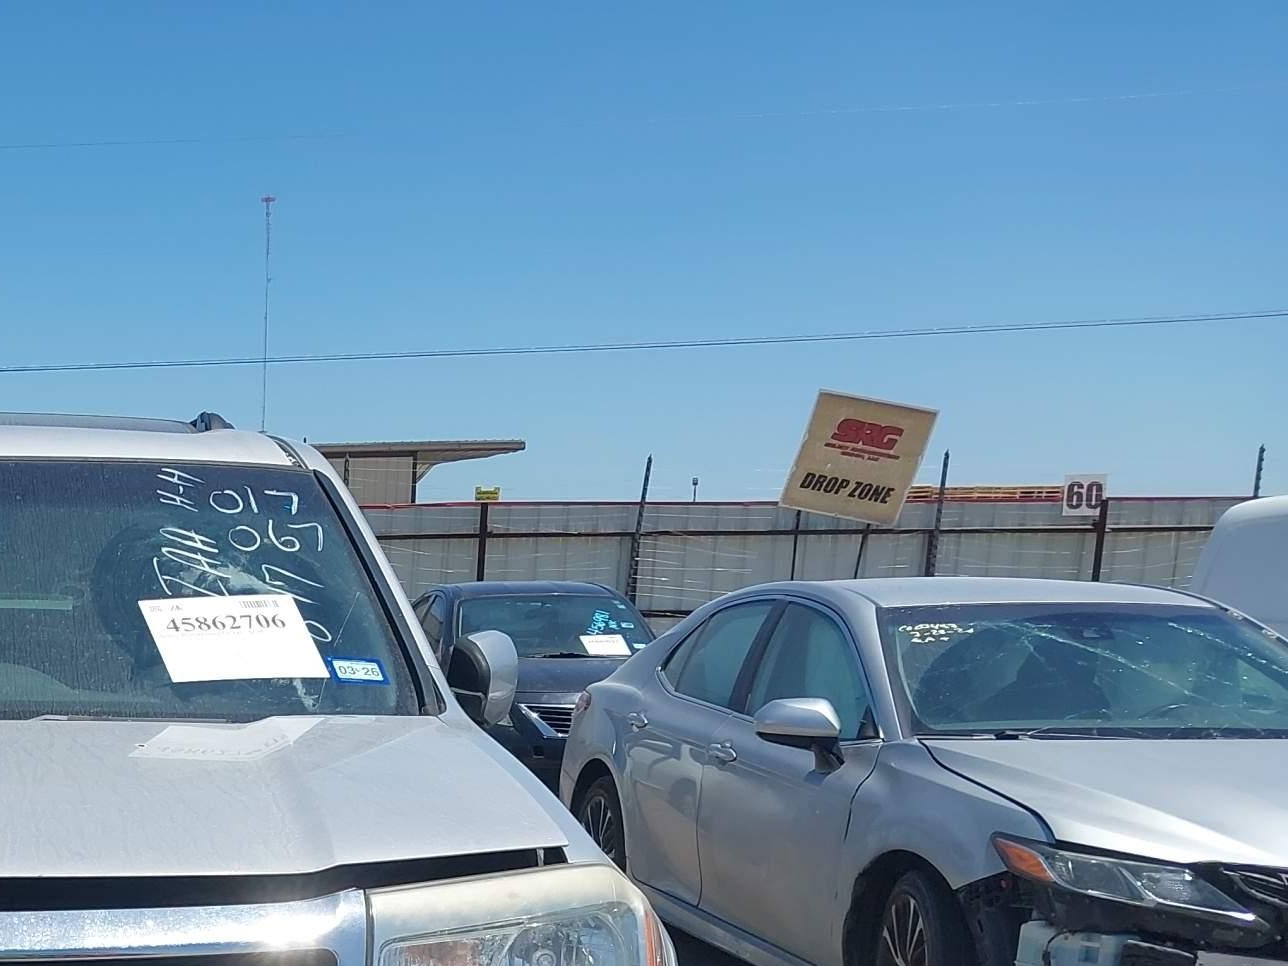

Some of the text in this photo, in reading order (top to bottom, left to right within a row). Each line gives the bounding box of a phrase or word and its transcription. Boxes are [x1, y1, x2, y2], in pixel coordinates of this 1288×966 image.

[799, 472, 896, 504] DROP ZONE
[1066, 481, 1103, 509] 60
[165, 613, 287, 633] 45862706
